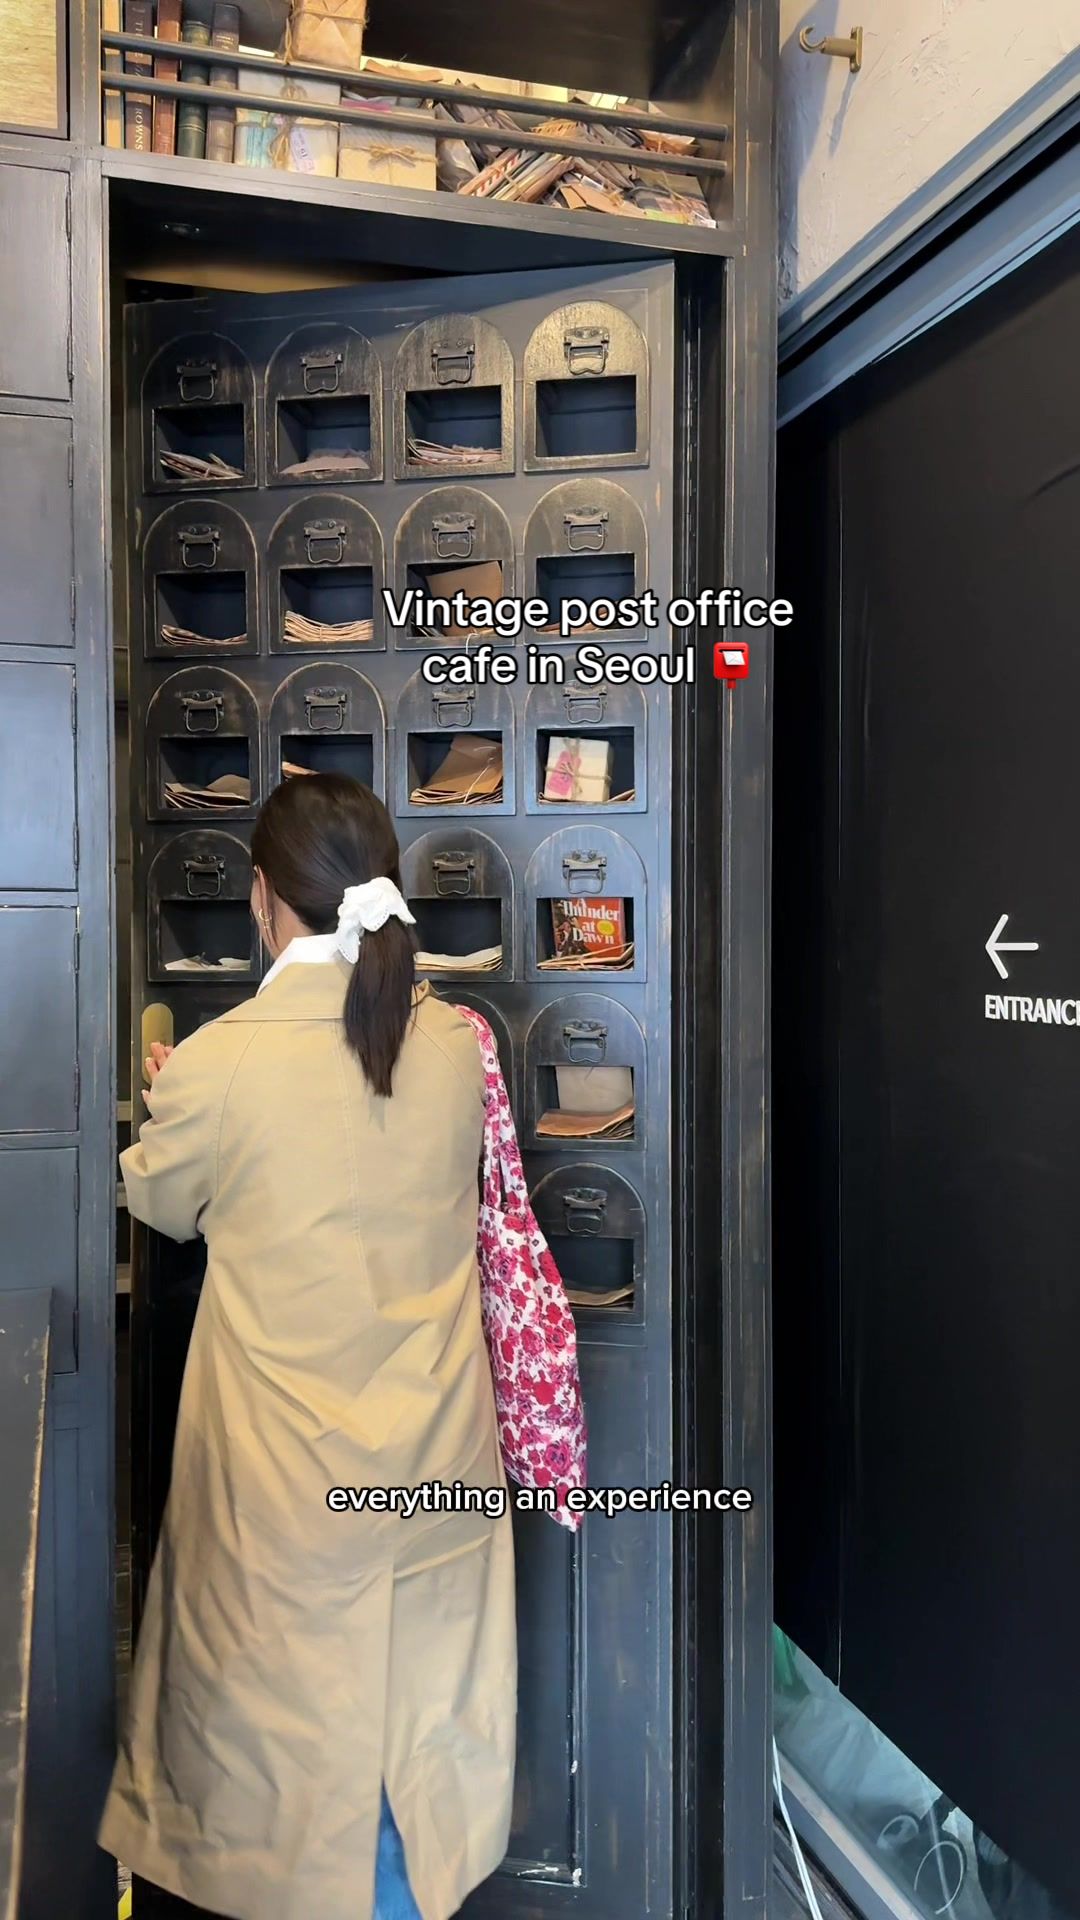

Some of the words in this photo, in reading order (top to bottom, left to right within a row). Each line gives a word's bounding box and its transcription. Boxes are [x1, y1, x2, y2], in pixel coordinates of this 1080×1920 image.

[558, 899, 620, 921] Thunder
[581, 920, 596, 933] at
[572, 927, 615, 945] Dawn
